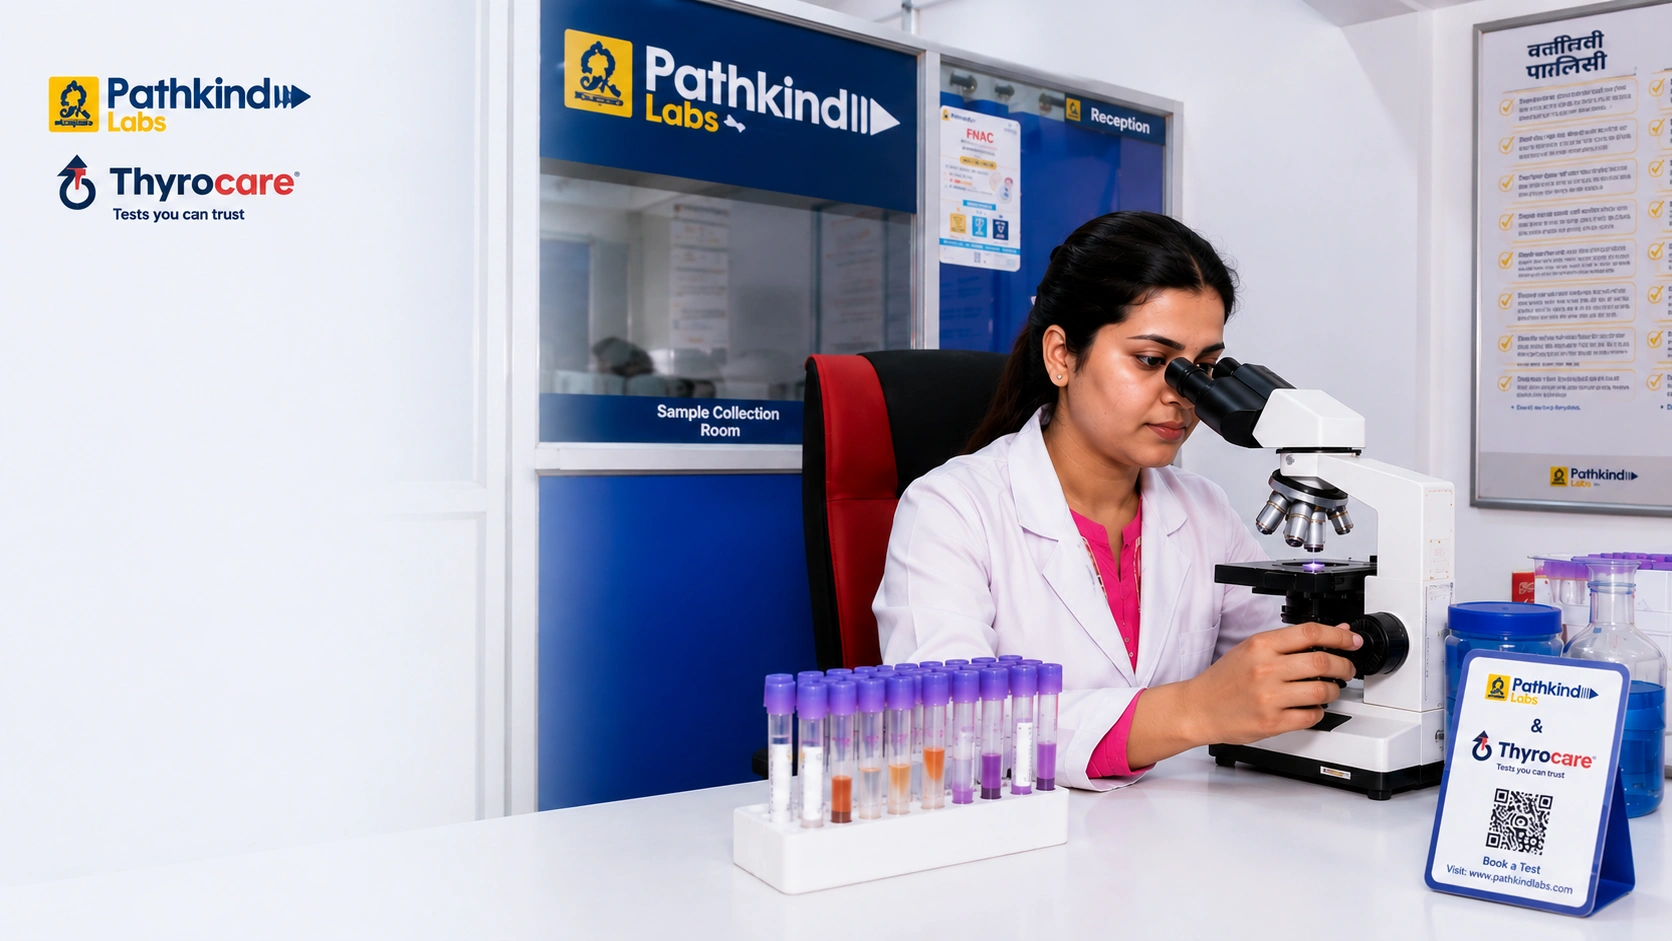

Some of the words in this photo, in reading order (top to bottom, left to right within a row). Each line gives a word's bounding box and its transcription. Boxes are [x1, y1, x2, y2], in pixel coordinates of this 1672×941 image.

[646, 45, 848, 131] Pathkind
[645, 93, 720, 133] Labs
[1090, 107, 1151, 135] Reception
[966, 128, 994, 144] FNAC
[657, 404, 710, 422] Sample
[712, 405, 780, 421] Collection
[700, 423, 741, 437] Room
[1570, 467, 1625, 481] Pathkind
[1512, 677, 1582, 699] Pathkind
[1510, 692, 1539, 705] Labs
[1530, 718, 1543, 734] &
[1498, 741, 1593, 769] Thyrocare
[1496, 763, 1516, 773] Tests
[1516, 767, 1531, 775] you
[1532, 769, 1546, 777] can
[1547, 770, 1565, 779] trust
[1482, 856, 1508, 869] Book
[1510, 862, 1517, 871] a
[1520, 862, 1541, 875] Test
[1446, 864, 1467, 876] Visit:
[1469, 869, 1573, 895] www.pathkindlabs.com
